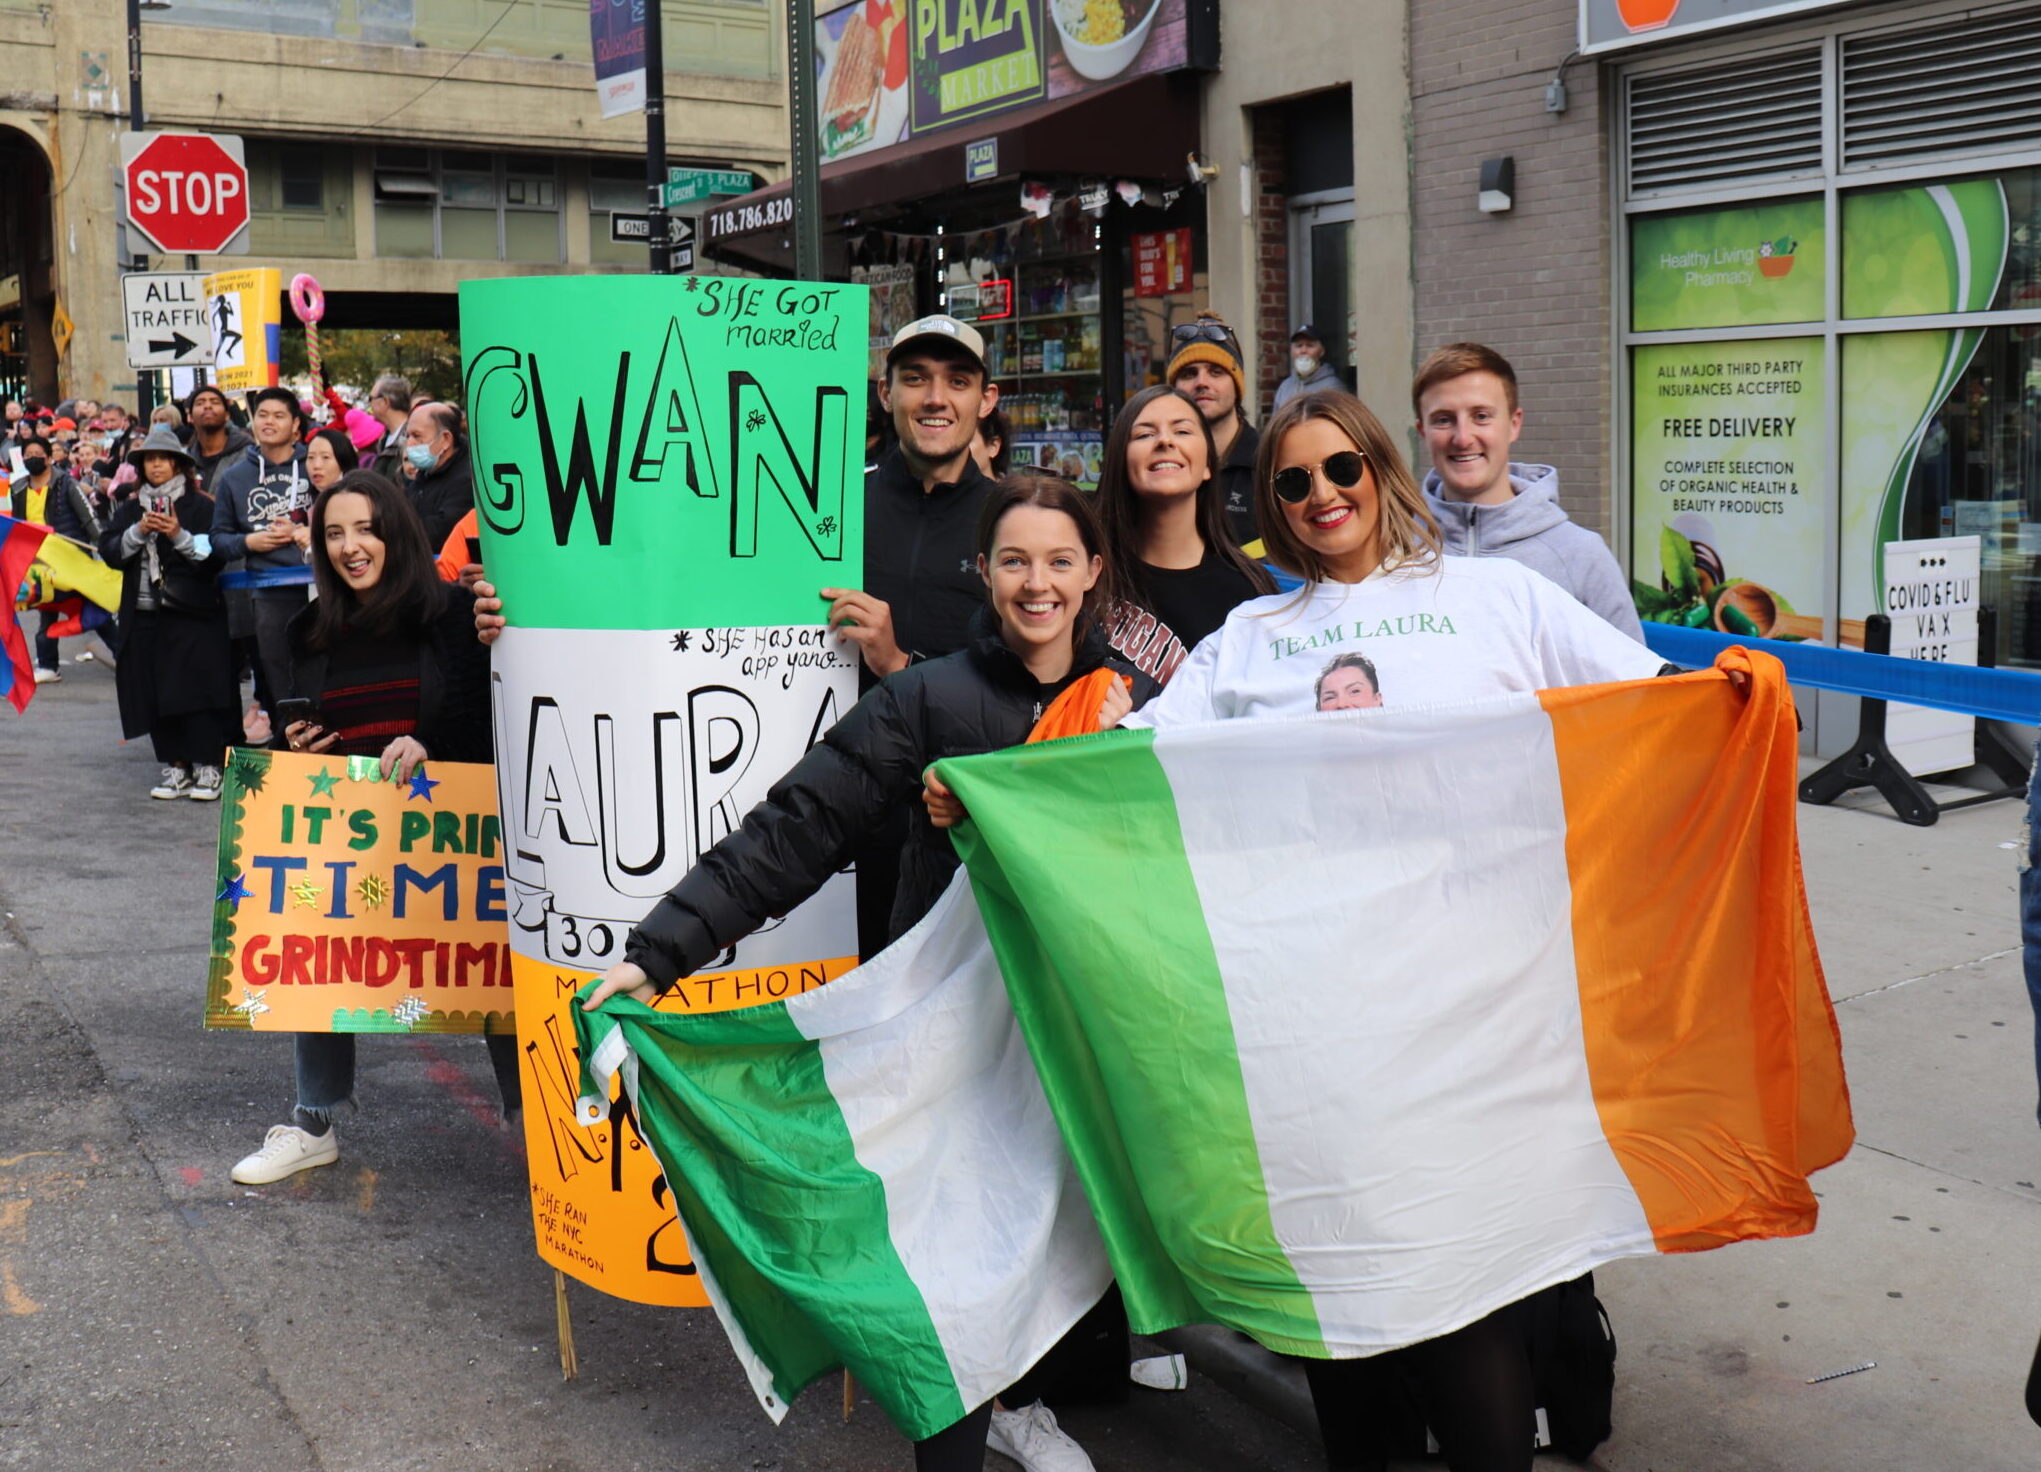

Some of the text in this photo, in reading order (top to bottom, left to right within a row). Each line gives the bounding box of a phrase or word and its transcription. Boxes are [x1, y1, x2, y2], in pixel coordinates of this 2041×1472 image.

[916, 0, 1036, 59] PLAZA
[941, 52, 1035, 109] MARKET
[969, 145, 994, 164] PLAZA
[136, 170, 240, 215] STOP
[667, 179, 696, 204] Crescent
[718, 174, 749, 187] PLAZA
[624, 221, 648, 235] ONE
[710, 197, 792, 237] 718.786.820
[1660, 247, 1754, 269] Healthy Living
[214, 283, 233, 295] LOVE
[236, 280, 254, 291] YOU
[1684, 269, 1754, 287] Pharmacy
[145, 282, 195, 303] ALL
[775, 287, 841, 316] GOT
[1657, 360, 1803, 379] ALL MAJOR THIRD PARTY
[1658, 380, 1802, 397] INSURANCES ACCEPTED
[464, 315, 849, 562] GWAN
[1663, 417, 1796, 438] FREE DELIVERY
[1664, 460, 1794, 475] COMPLETE SELECTION
[1659, 479, 1799, 495] OF ORGANIC HEALTH &
[1673, 499, 1784, 514] BEAUTY PRODUCTS
[1888, 583, 1930, 611] COVID
[1945, 579, 1970, 604] FLU
[1269, 612, 1458, 661] TEAM LAURA
[1917, 613, 1951, 639] VAX
[742, 655, 779, 681] app
[281, 804, 379, 852] IT'S
[252, 855, 508, 922] TIME
[556, 964, 828, 1009] MATHON
[564, 1202, 587, 1225] RAN
[538, 1213, 583, 1245] THE NYC
[545, 1233, 604, 1274] MARATHON
